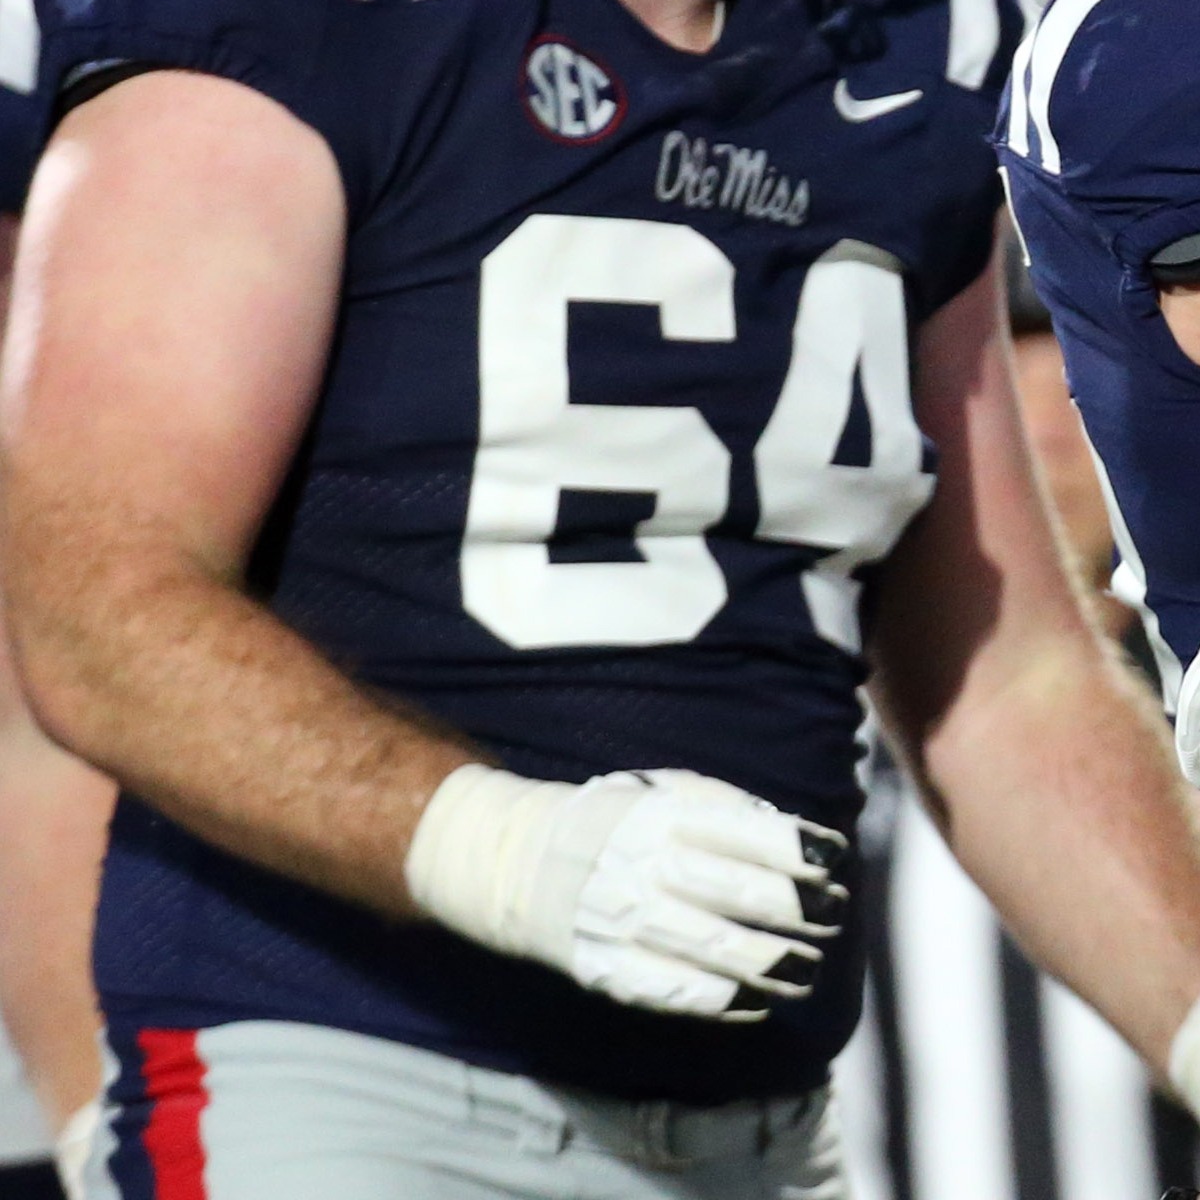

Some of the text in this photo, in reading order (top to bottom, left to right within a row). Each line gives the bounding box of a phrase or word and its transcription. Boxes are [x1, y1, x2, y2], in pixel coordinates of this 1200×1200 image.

[526, 42, 618, 139] SEC
[655, 129, 811, 227] Ole Miss
[459, 213, 938, 655] 64
